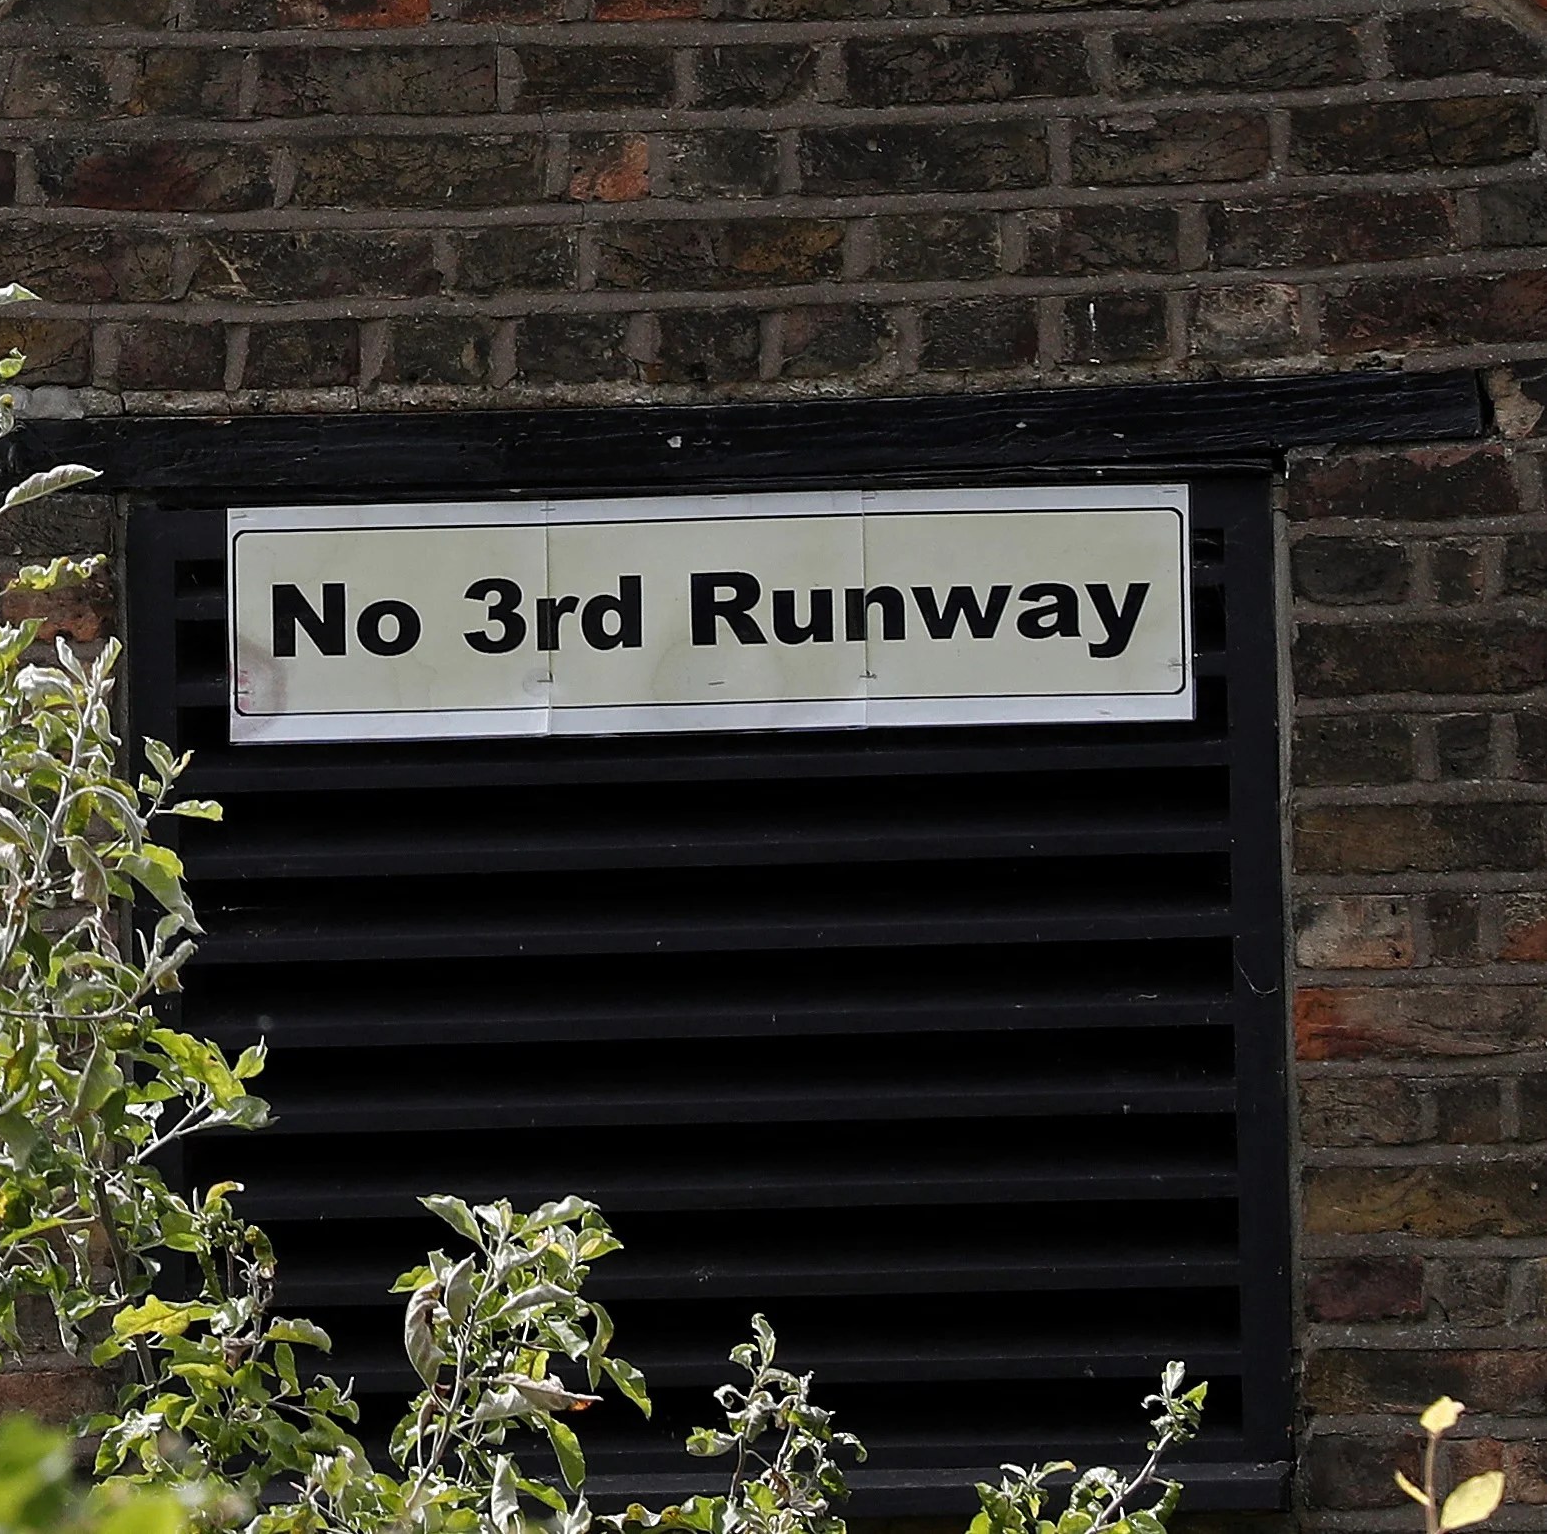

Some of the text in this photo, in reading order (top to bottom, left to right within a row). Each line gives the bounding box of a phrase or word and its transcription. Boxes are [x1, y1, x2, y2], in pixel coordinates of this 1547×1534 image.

[271, 571, 1151, 659] No 3rd Runway
